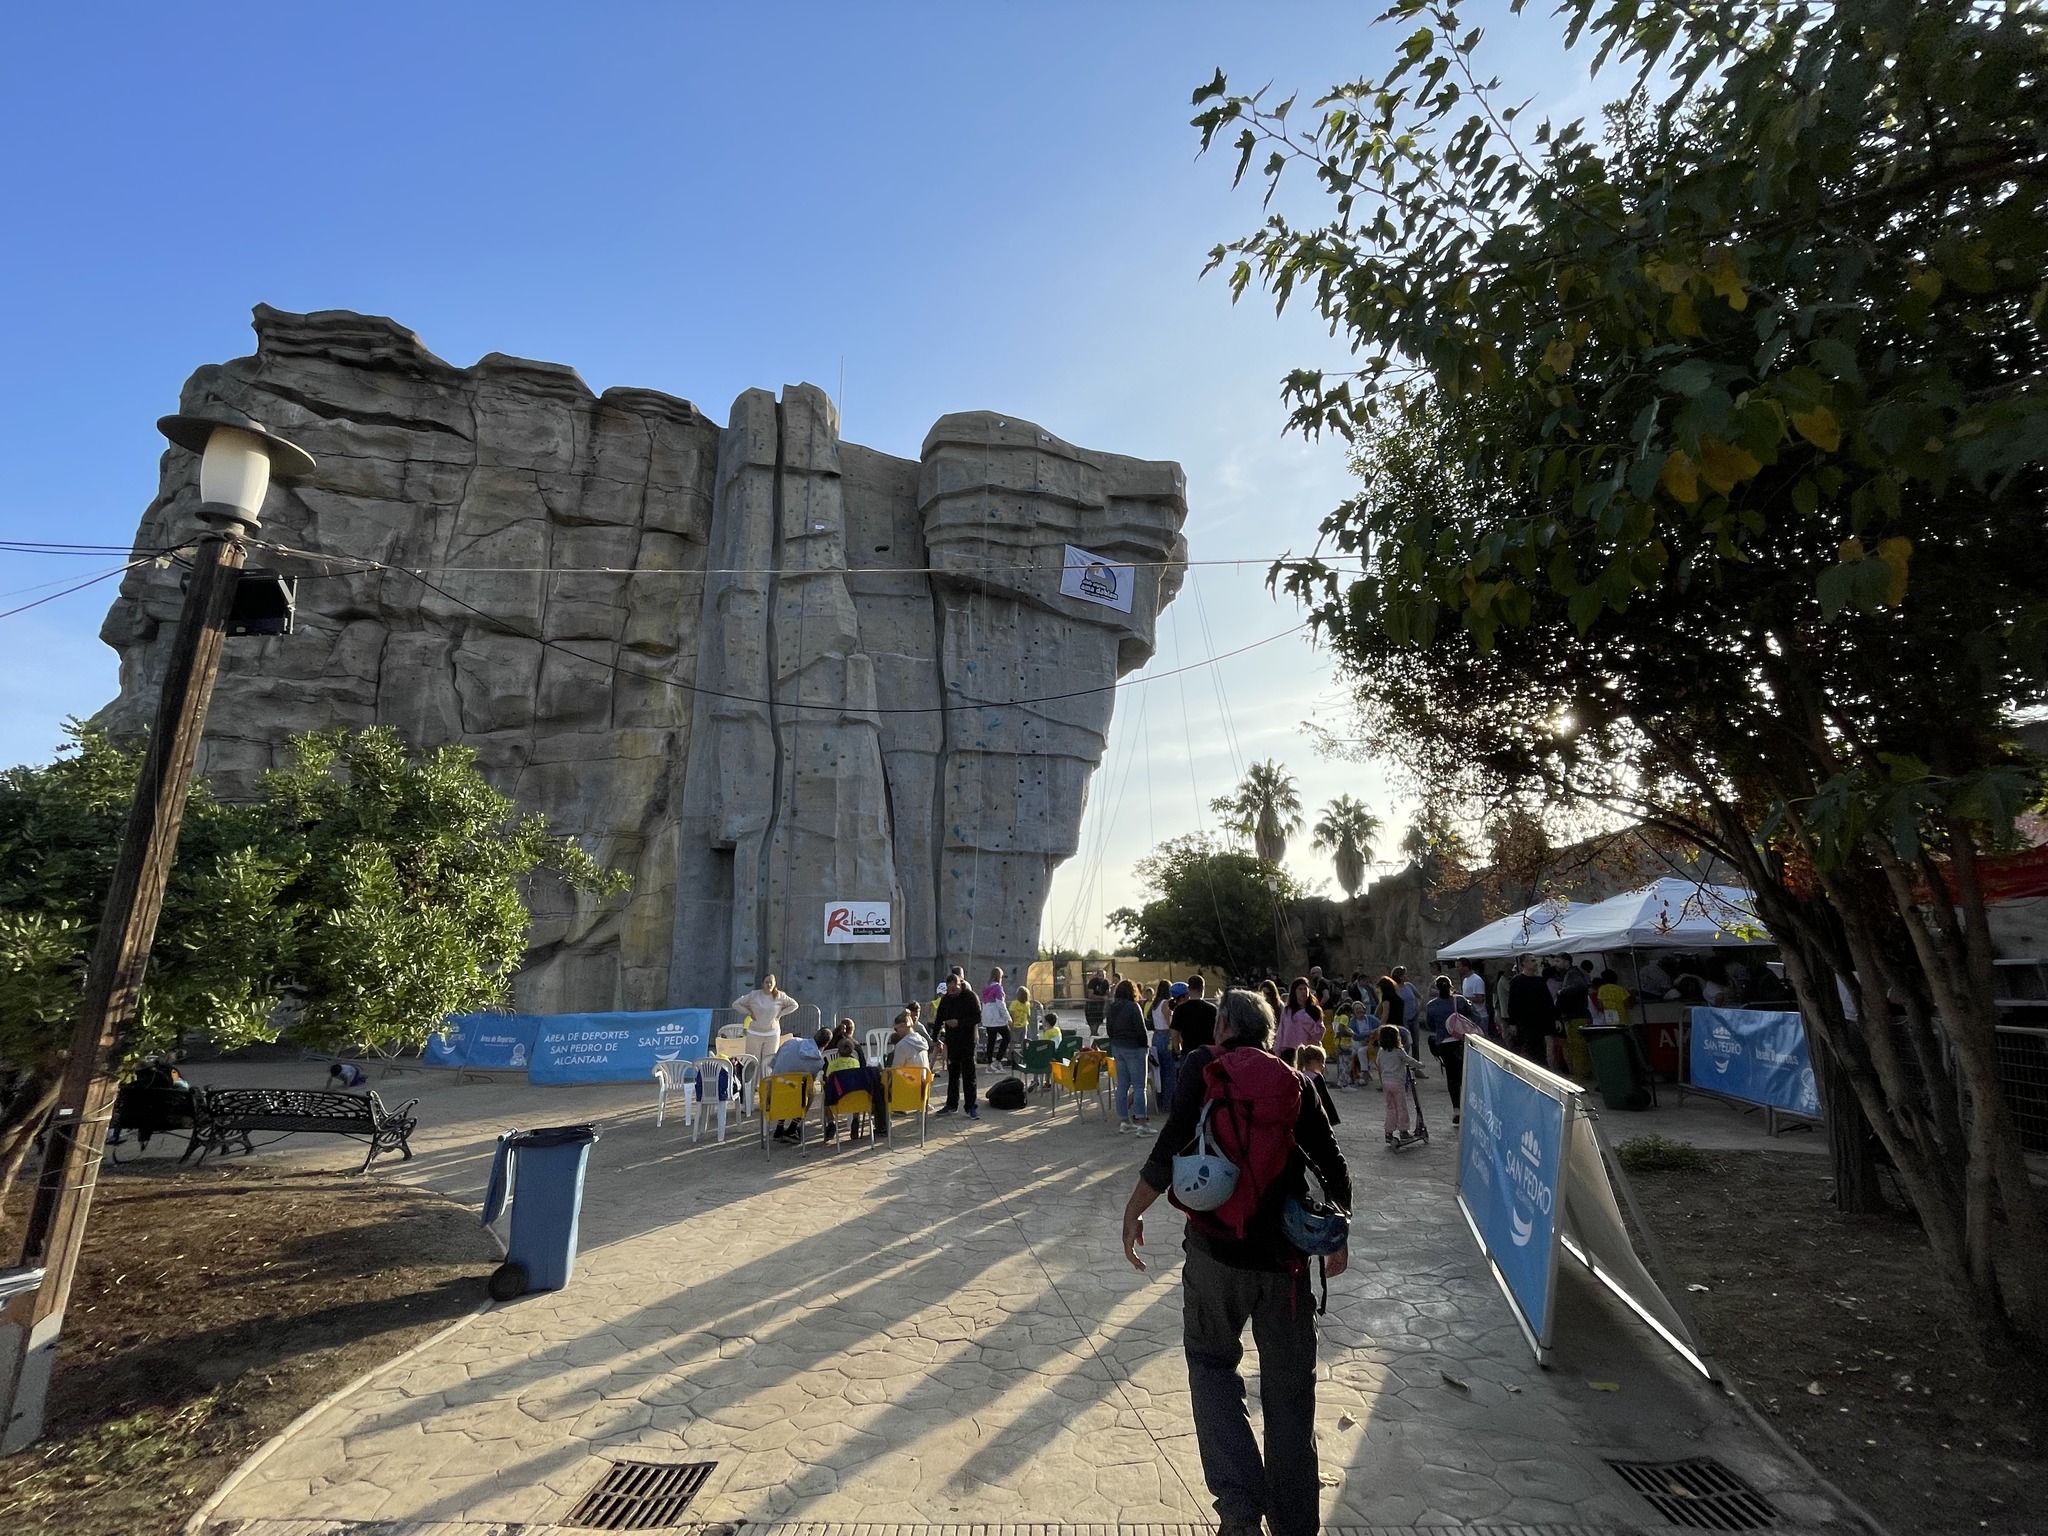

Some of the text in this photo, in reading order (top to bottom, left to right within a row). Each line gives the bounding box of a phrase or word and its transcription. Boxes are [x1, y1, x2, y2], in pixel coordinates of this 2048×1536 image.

[827, 908, 887, 936] Relief.es
[544, 1030, 630, 1043] ÁREA DE DEPORTES
[638, 1034, 700, 1048] SAN PEDRO
[550, 1042, 618, 1055] SAN PEDRO DE
[1703, 1039, 1718, 1052] SAN
[1718, 1041, 1742, 1056] PEDRO
[553, 1054, 609, 1066] ALCÁNTARA
[1506, 1149, 1523, 1184] SAN
[1523, 1165, 1552, 1216] PEDRO
